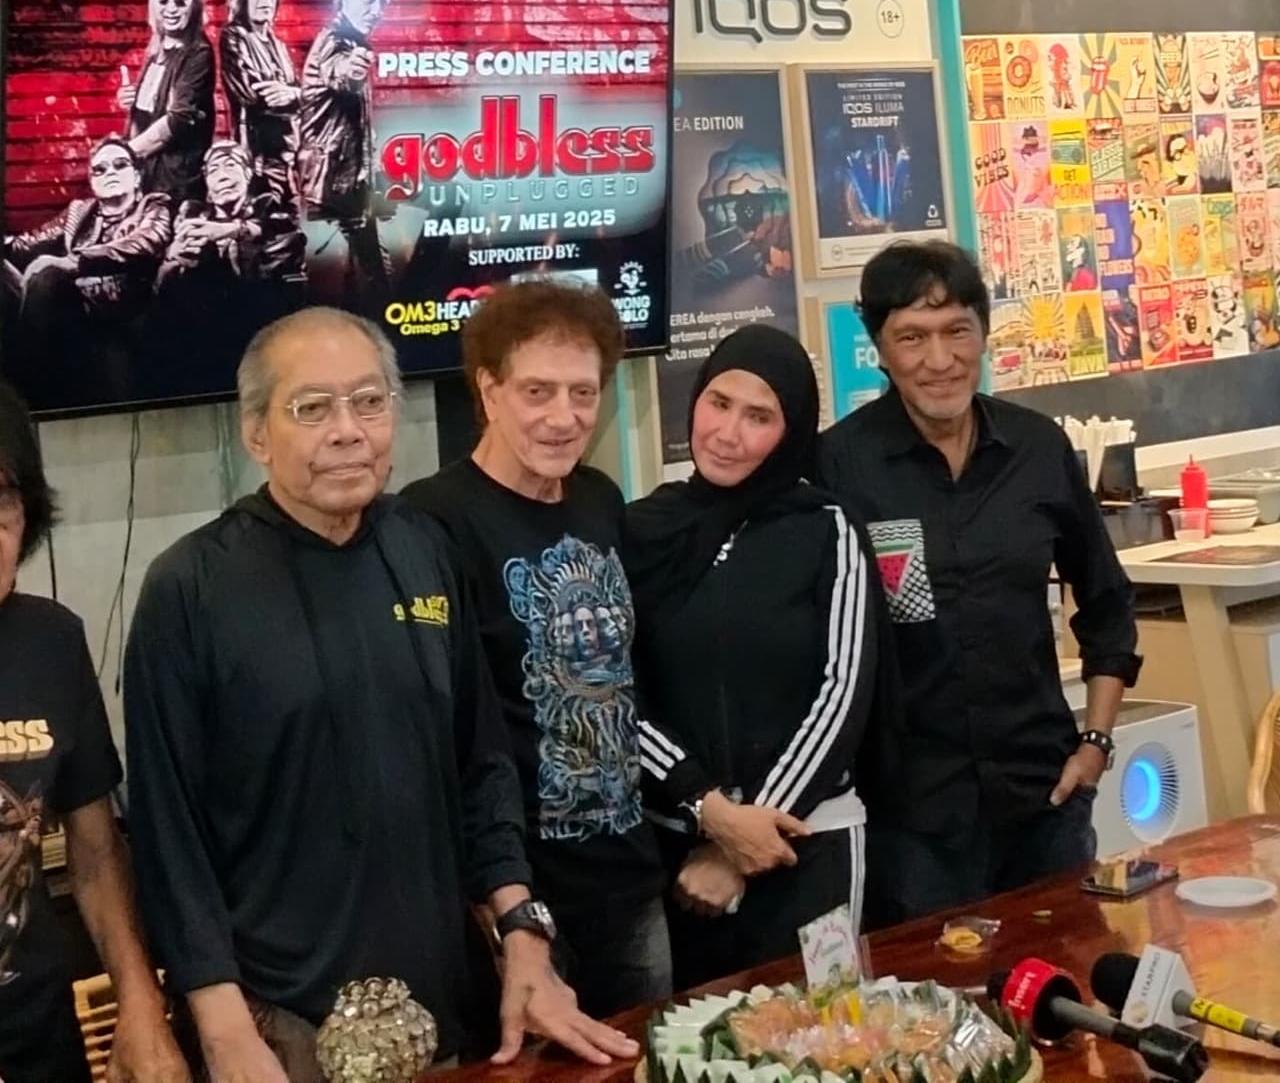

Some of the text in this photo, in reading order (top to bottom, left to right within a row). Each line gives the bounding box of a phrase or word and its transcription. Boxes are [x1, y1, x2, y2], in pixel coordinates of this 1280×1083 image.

[881, 10, 900, 23] 18+
[378, 50, 650, 77] PRESS CONFERENCE
[843, 103, 873, 114] IQOS
[694, 116, 744, 131] EDITION
[381, 94, 656, 201] godbless
[975, 147, 1007, 170] GOOD
[429, 177, 640, 206] UNPLUGGED
[423, 209, 616, 237] RABU, 7 MEI 2025
[469, 243, 580, 266] SUPPORTED BY:
[400, 320, 460, 335] Omega 3
